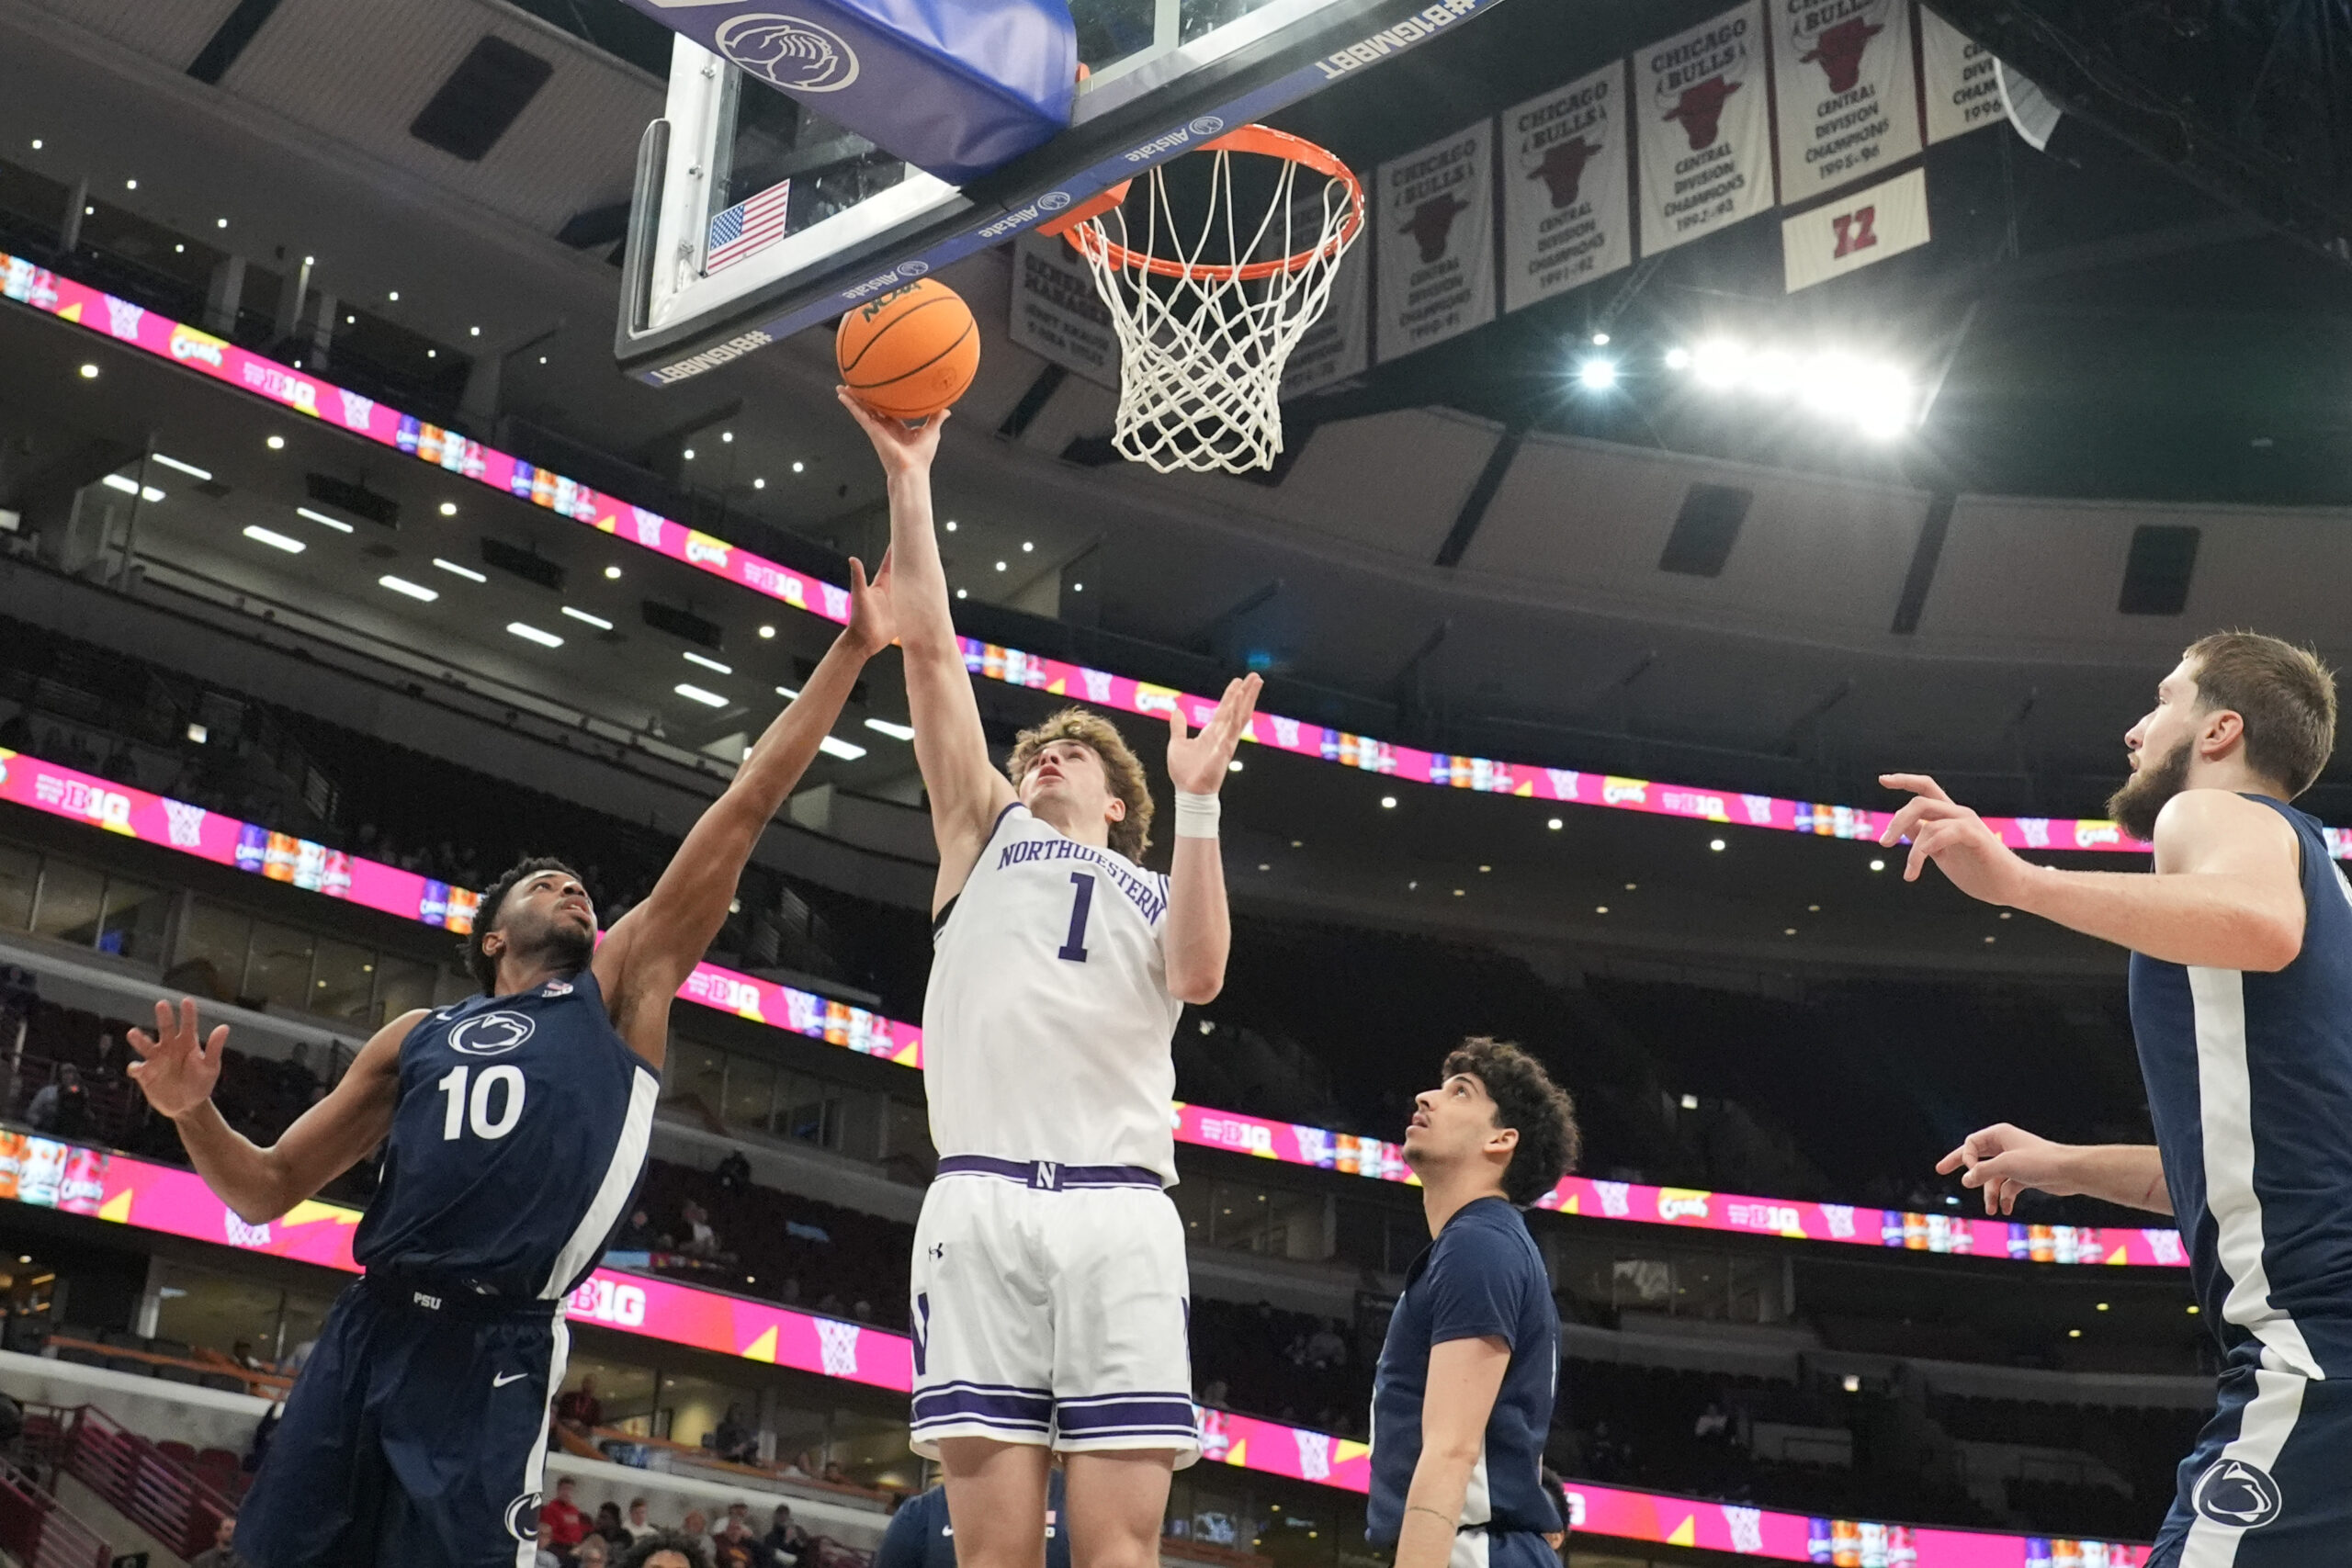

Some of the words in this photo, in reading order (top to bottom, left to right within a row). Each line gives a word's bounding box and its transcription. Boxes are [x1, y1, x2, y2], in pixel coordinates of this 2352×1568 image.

[1651, 18, 1747, 73] CHICAGO
[1668, 46, 1735, 89] BULLS
[1519, 81, 1608, 132] CHICAGO
[1815, 100, 1878, 140] DIVISION
[1817, 84, 1875, 117] CENTRAL
[1124, 128, 1189, 163] Allstate
[1805, 118, 1889, 164] CHAMPIONS
[979, 203, 1039, 239] Allstate
[1833, 205, 1878, 260] 72
[842, 271, 899, 300] Allstate
[997, 839, 1167, 926] NORTHWESTERN
[1057, 872, 1095, 963] 1
[438, 1064, 526, 1141] 10
[1036, 1160, 1057, 1190] N
[413, 1291, 442, 1311] PSU
